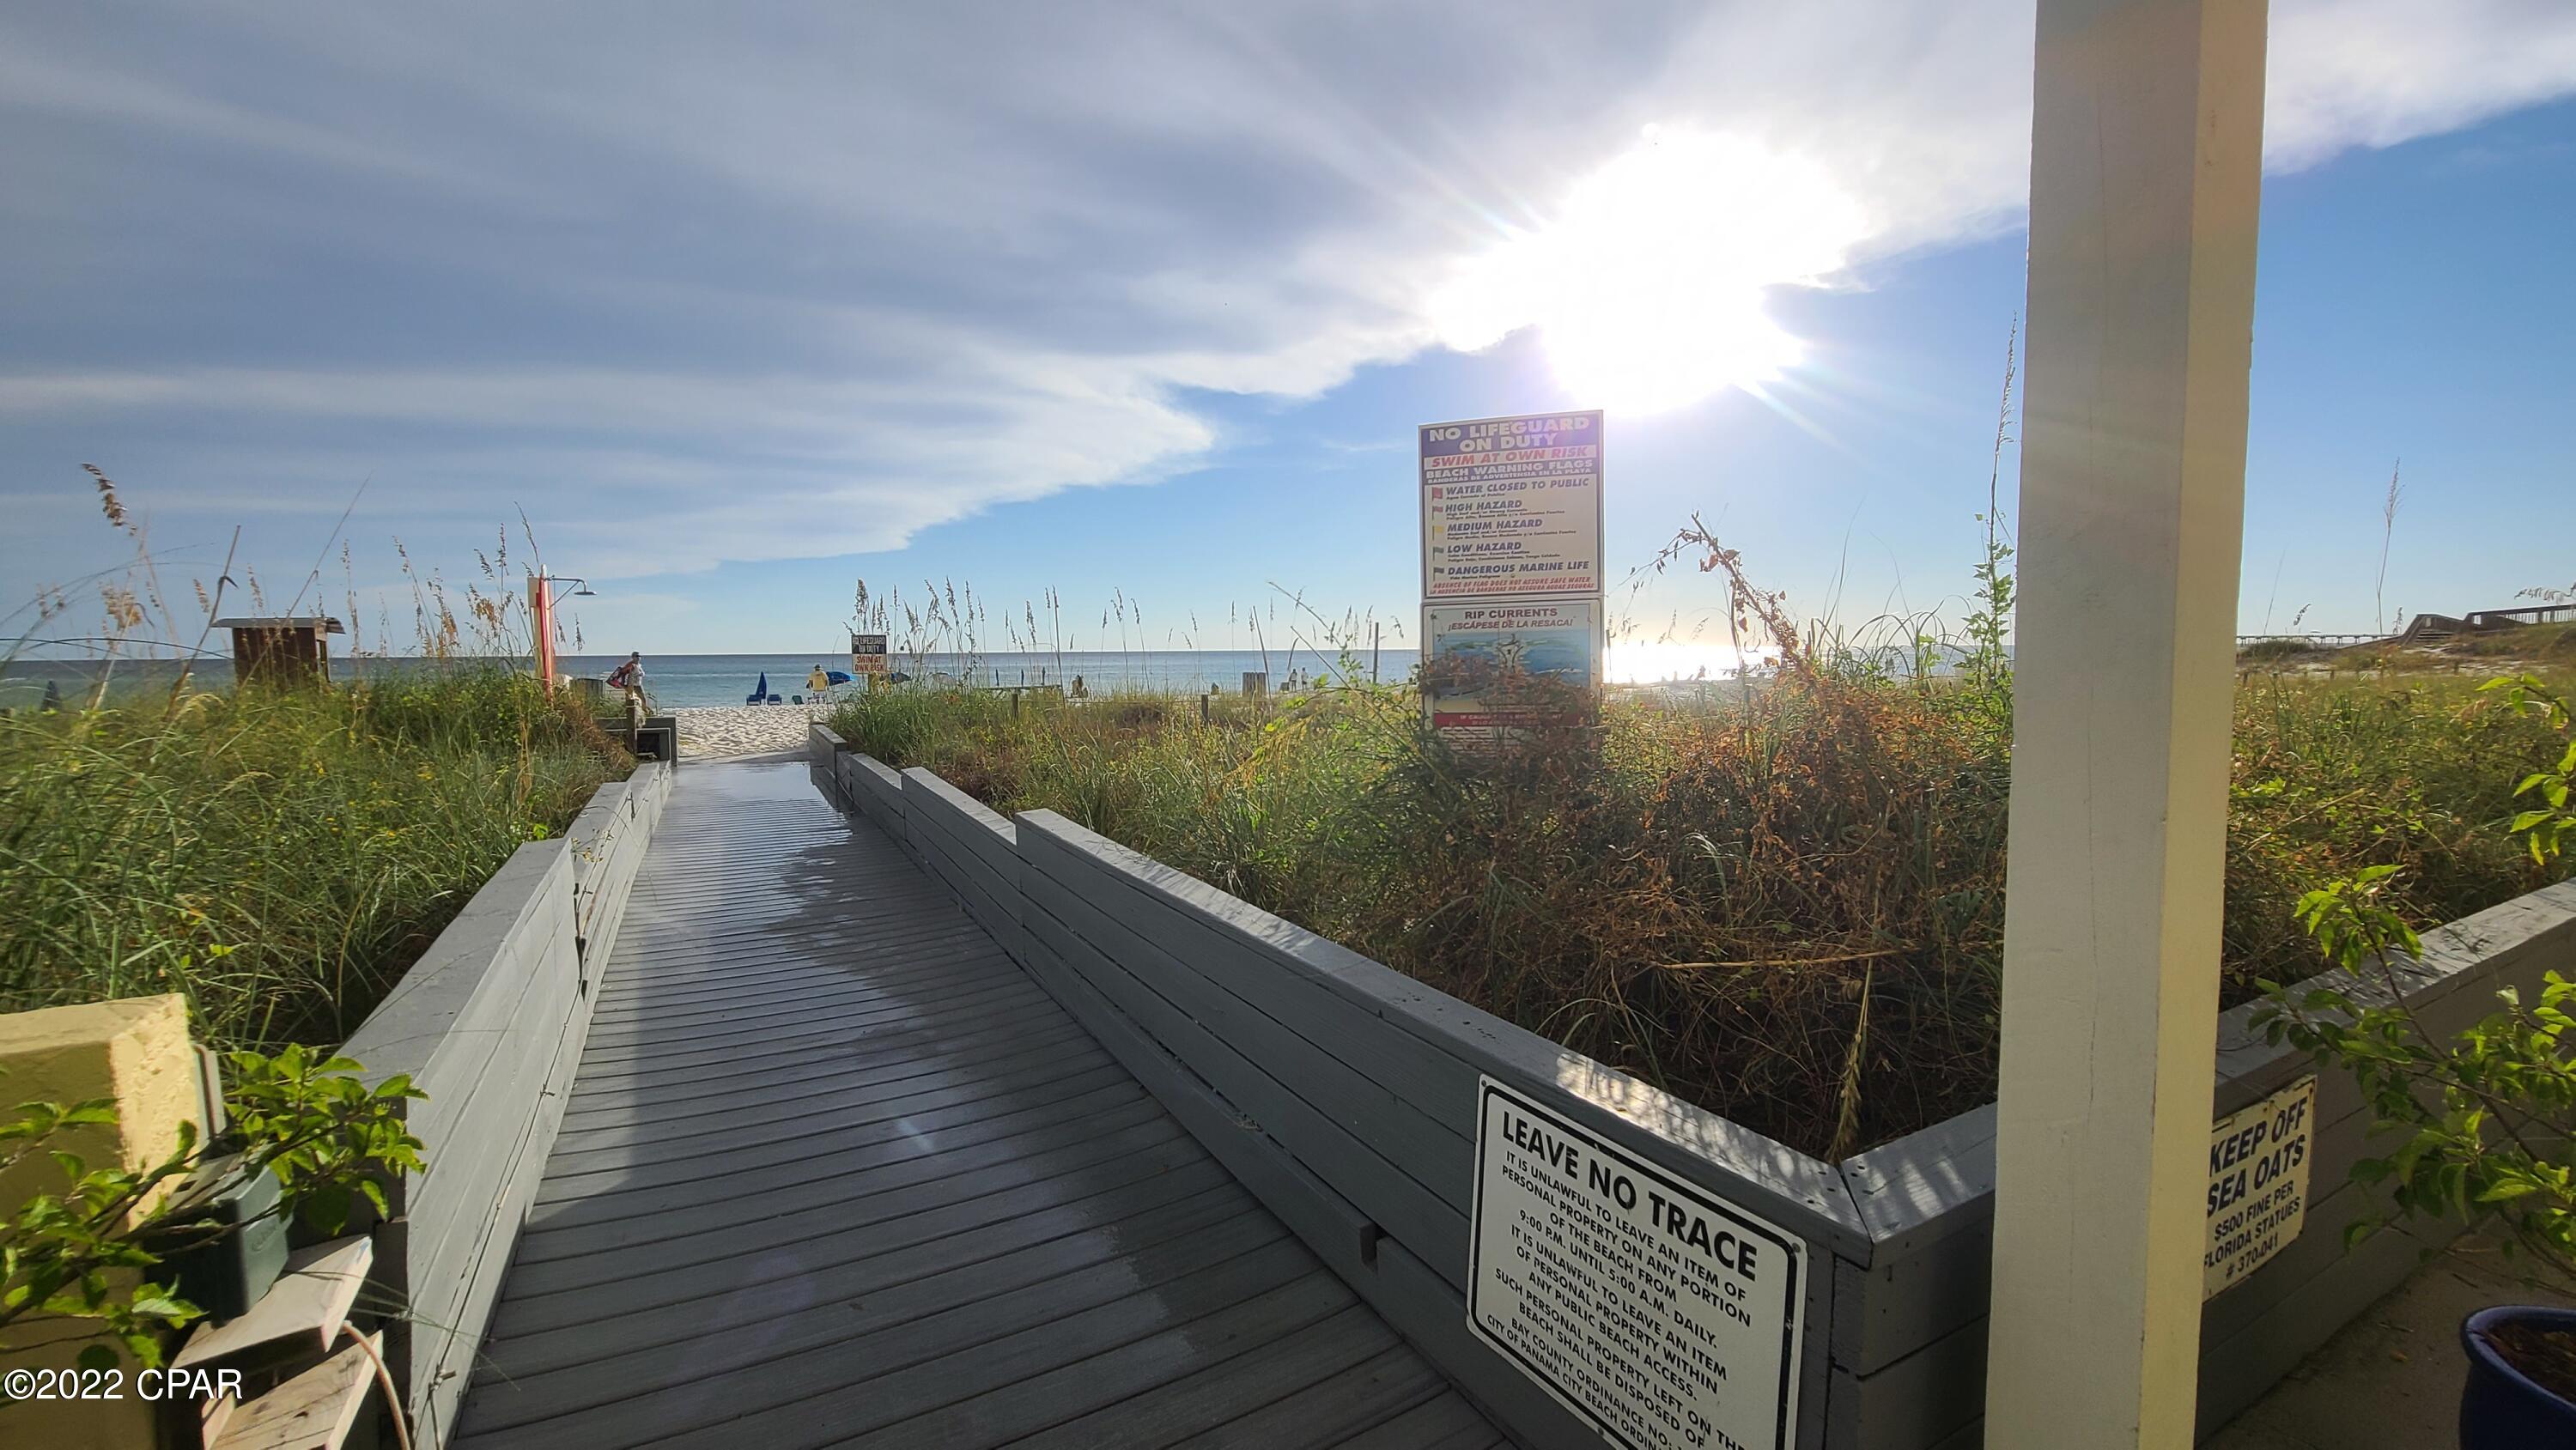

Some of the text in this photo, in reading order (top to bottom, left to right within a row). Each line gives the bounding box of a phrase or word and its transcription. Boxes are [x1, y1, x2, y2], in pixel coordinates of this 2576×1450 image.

[1426, 460, 1592, 478] BEACH WARNING FLAGS
[1430, 417, 1589, 442] NO LIFEGUARD
[1432, 446, 1588, 468] SWIM AT OWN RISK
[1460, 433, 1557, 452] ON DUTY
[1445, 503, 1473, 512] HIGH
[1477, 500, 1522, 510] HAZARD
[1446, 478, 1589, 494] WATER CLOSED TO PUBLIC
[1448, 519, 1542, 531] MEDIUM HAZARD
[1448, 543, 1522, 553] LOW HAZARD
[1448, 564, 1516, 575] DANGEROUS
[1519, 562, 1564, 572] MARINE
[1465, 608, 1558, 619] RIP CURRENTS
[2207, 1134, 2306, 1218] SEA OATS
[2209, 1095, 2308, 1178] KEEP OFF
[1503, 1111, 1757, 1282] LEAVE NO TRACE
[1507, 1150, 1746, 1301] IT IS UNLAWFUL TO LEAVE AN ITEM OF
[2215, 1180, 2294, 1241] $500 FINE PER
[2255, 1197, 2300, 1239] STATUES
[1503, 1164, 1750, 1327] PERSONAL PROPERTY ON ANY PORTION
[1520, 1210, 1716, 1349] 9:00 P.M. UNTIL 5:00 A.M. DAILY.
[1550, 1212, 1677, 1302] OF THE BEACH FROM
[1511, 1224, 1727, 1380] IT IS UNLAWFUL TO LEAVE AN ITEM
[1516, 1246, 1717, 1394] OF PERSONAL PROPERTY WITHIN
[1529, 1271, 1697, 1401] ANY PUBLIC BEACH ACCESS.
[1487, 1314, 1505, 1333] CITY
[1507, 1329, 1518, 1344] OF
[1521, 1339, 1559, 1378] PANAMA
[1563, 1373, 1583, 1394] CITY
[1585, 1390, 1617, 1423] BEACH
[1496, 1268, 1522, 1295] SUCH
[1526, 1289, 1583, 1341] PERSONAL
[1587, 1335, 1649, 1388] PROPERTY
[1654, 1383, 1683, 1414] LEFT
[1687, 1411, 1711, 1436] ON
[1512, 1318, 1530, 1338] BAY
[1533, 1334, 1574, 1372] COUNTY
[1577, 1369, 1643, 1429] ORDINANCE
[1519, 1301, 1704, 1448] BEACH SHALL BE DISPOSED OF
